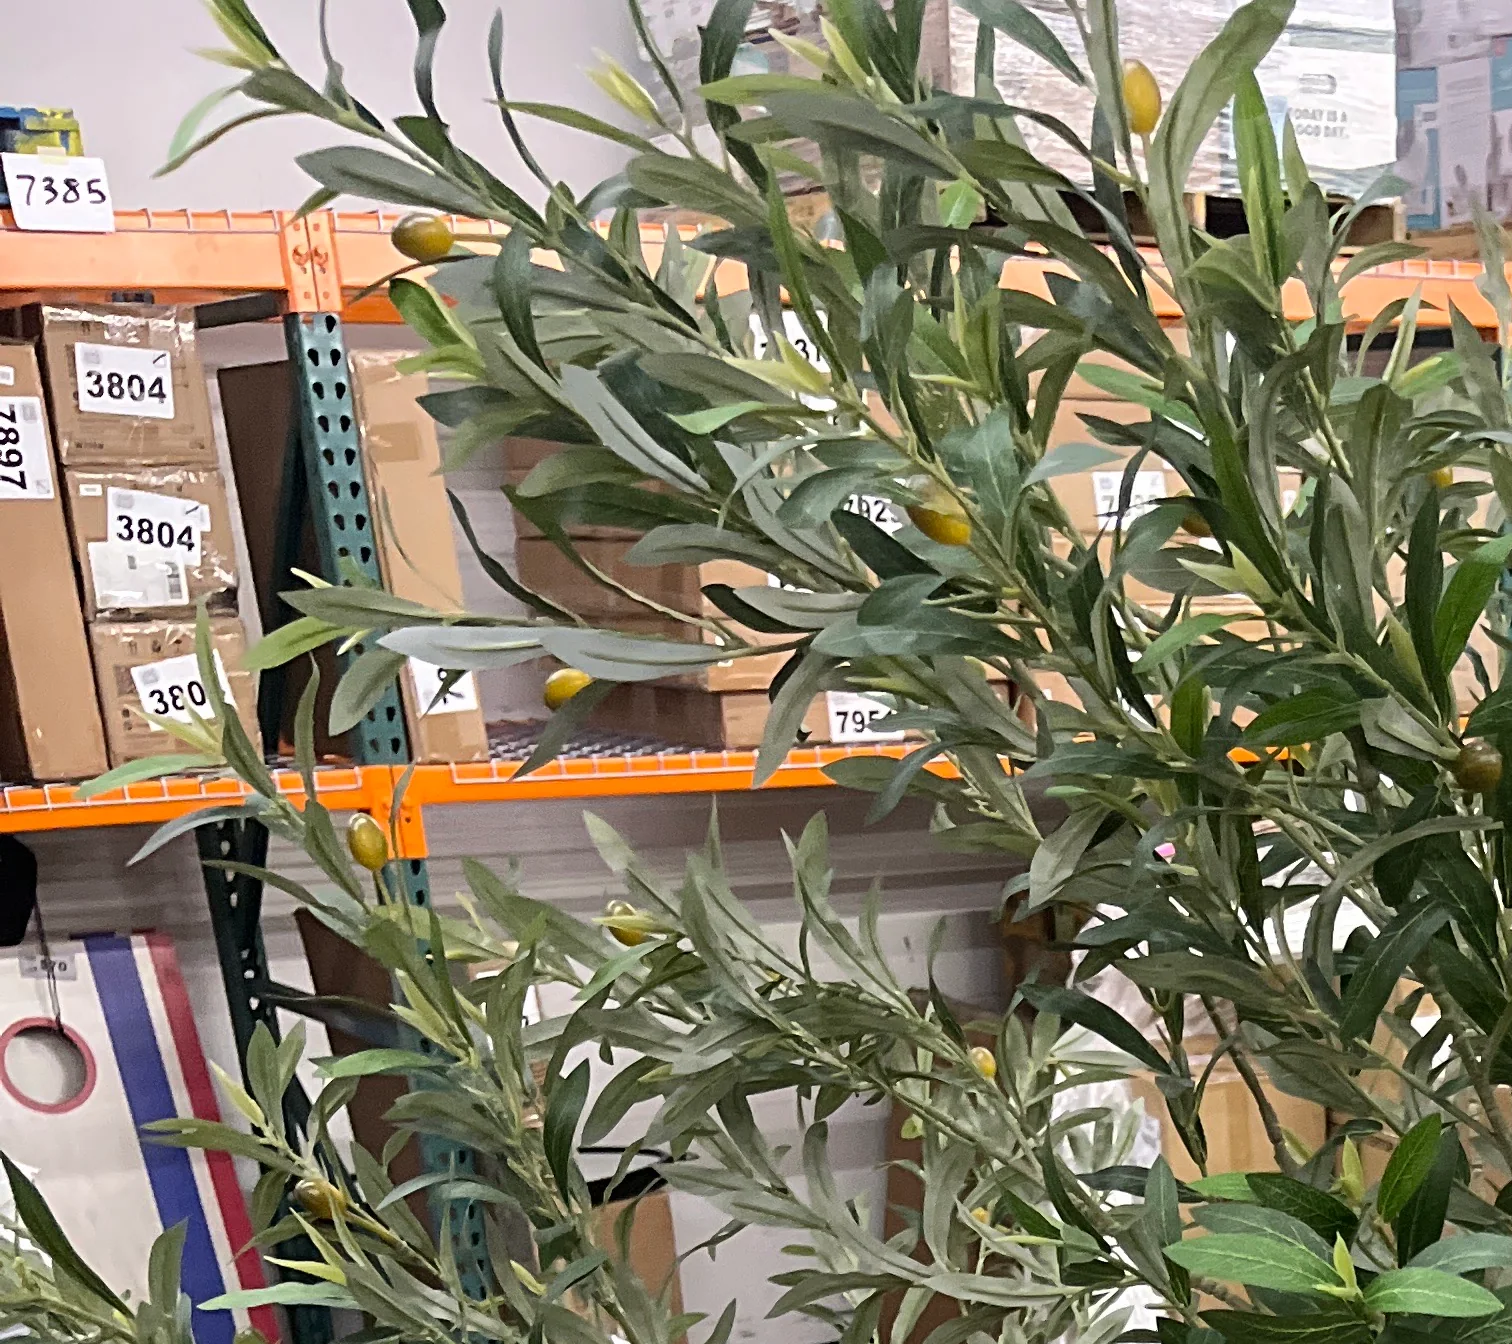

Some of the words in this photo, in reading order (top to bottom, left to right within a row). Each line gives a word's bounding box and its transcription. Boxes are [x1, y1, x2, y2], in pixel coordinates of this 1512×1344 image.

[16, 173, 107, 205] 7385
[85, 370, 167, 405] 3804
[0, 403, 28, 491] 7897
[116, 514, 196, 552] 3804
[148, 680, 207, 715] 380
